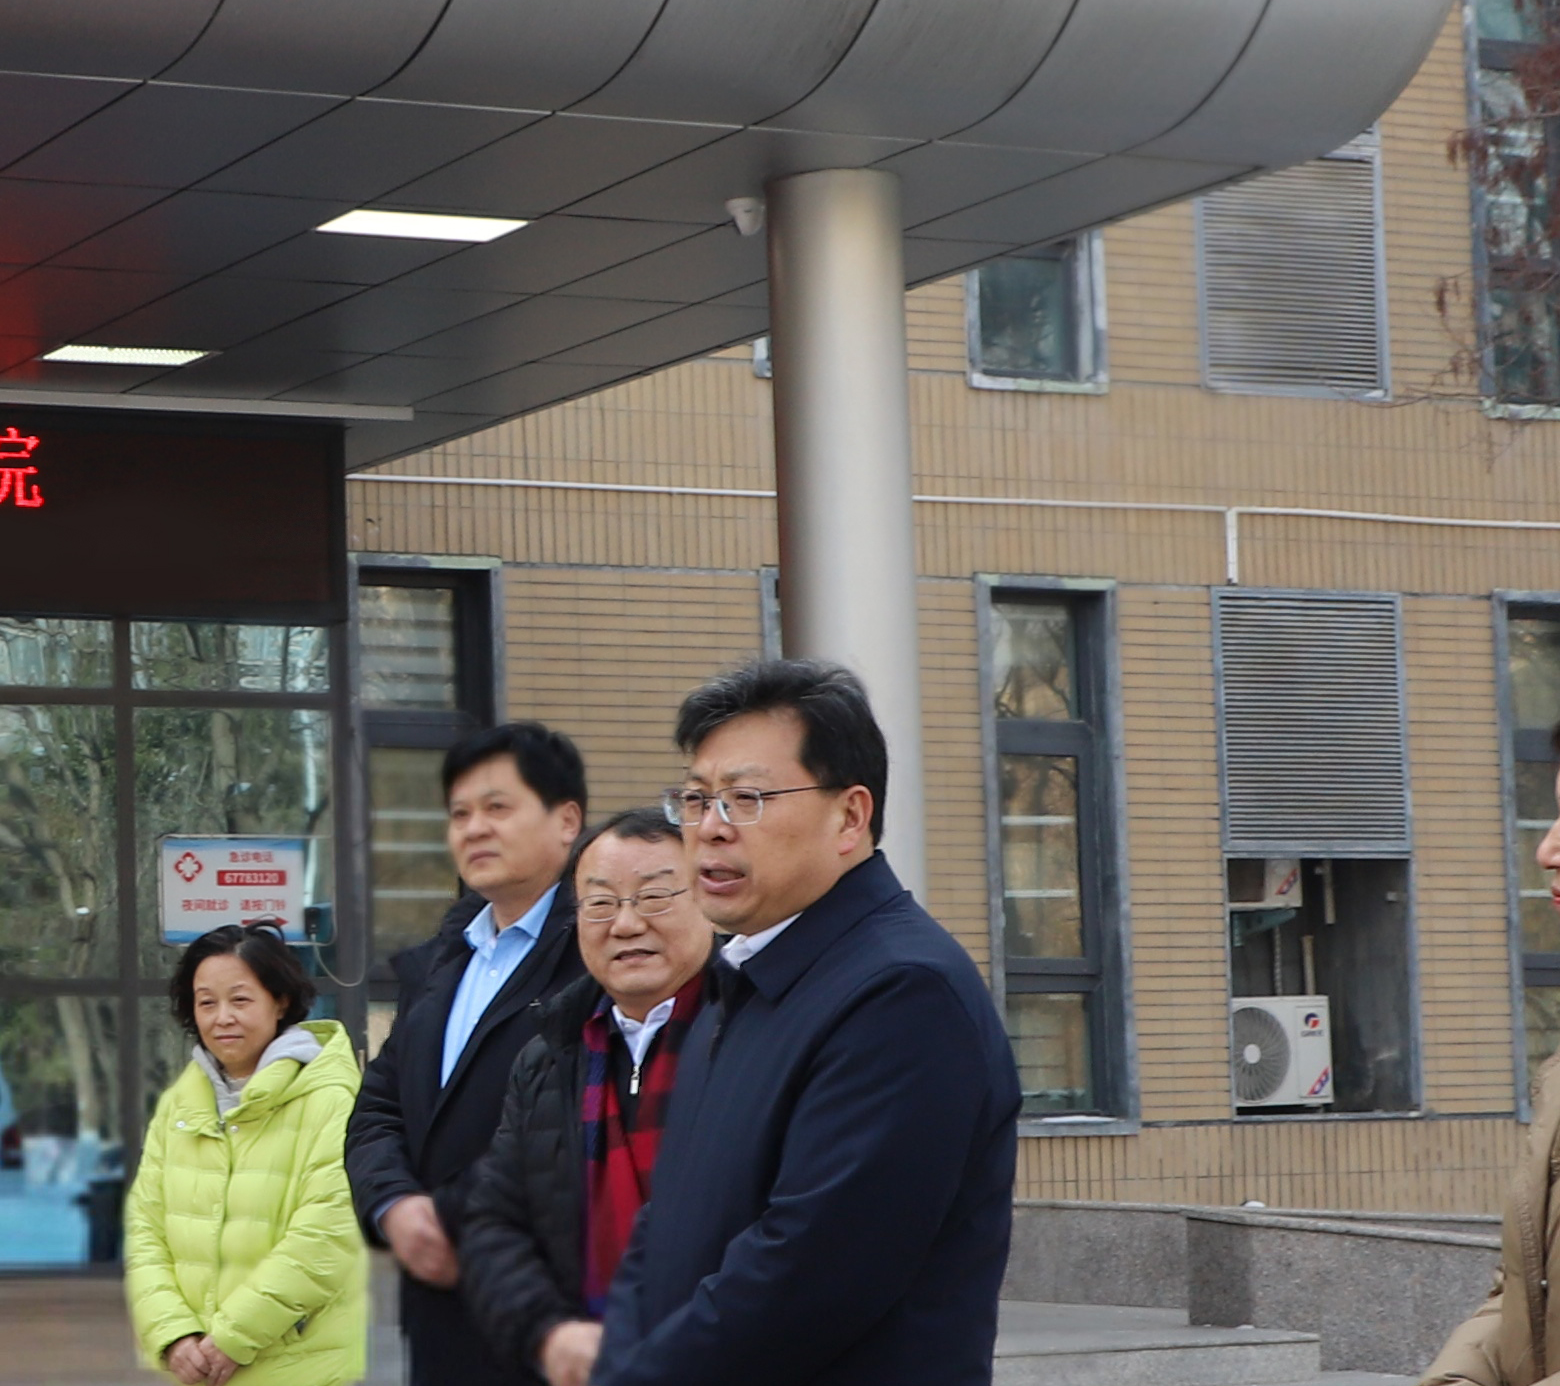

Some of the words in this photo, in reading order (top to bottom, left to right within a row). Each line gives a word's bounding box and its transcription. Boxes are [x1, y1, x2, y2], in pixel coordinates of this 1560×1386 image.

[229, 850, 274, 863] 急诊电话
[181, 898, 229, 911] 夜间就诊
